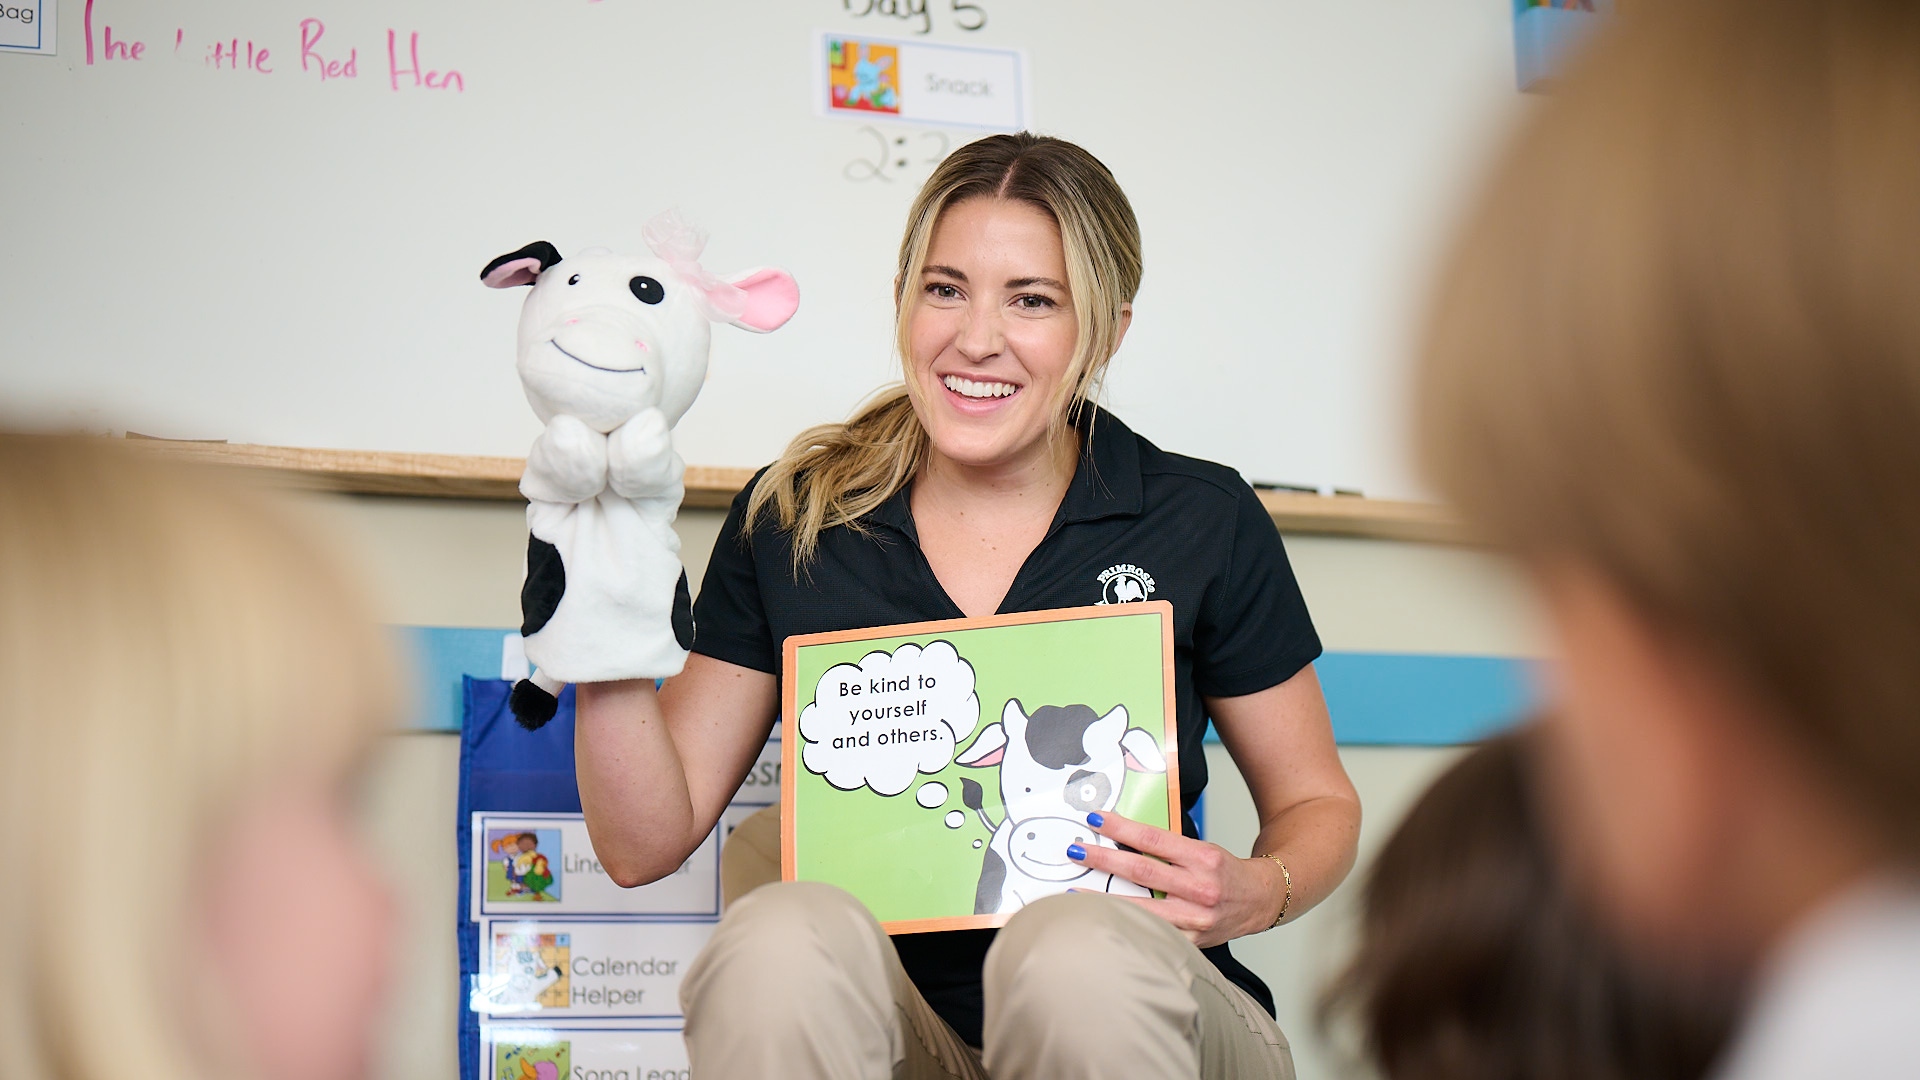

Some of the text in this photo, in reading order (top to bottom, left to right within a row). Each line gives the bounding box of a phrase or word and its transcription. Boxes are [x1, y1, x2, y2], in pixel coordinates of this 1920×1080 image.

[952, 0, 988, 31] 5
[84, 0, 146, 66] The
[300, 17, 357, 82] Red
[387, 27, 464, 93] Hen
[925, 72, 993, 98] Snack
[842, 125, 950, 187] 2:3
[1096, 563, 1156, 588] PRIMROSE
[839, 674, 936, 697] Be kind to
[849, 699, 927, 726] yourself
[832, 728, 943, 749] and others.
[563, 852, 606, 874] Line
[571, 956, 678, 977] Calendar
[571, 986, 645, 1008] Helper
[636, 1065, 691, 1080] Lead
